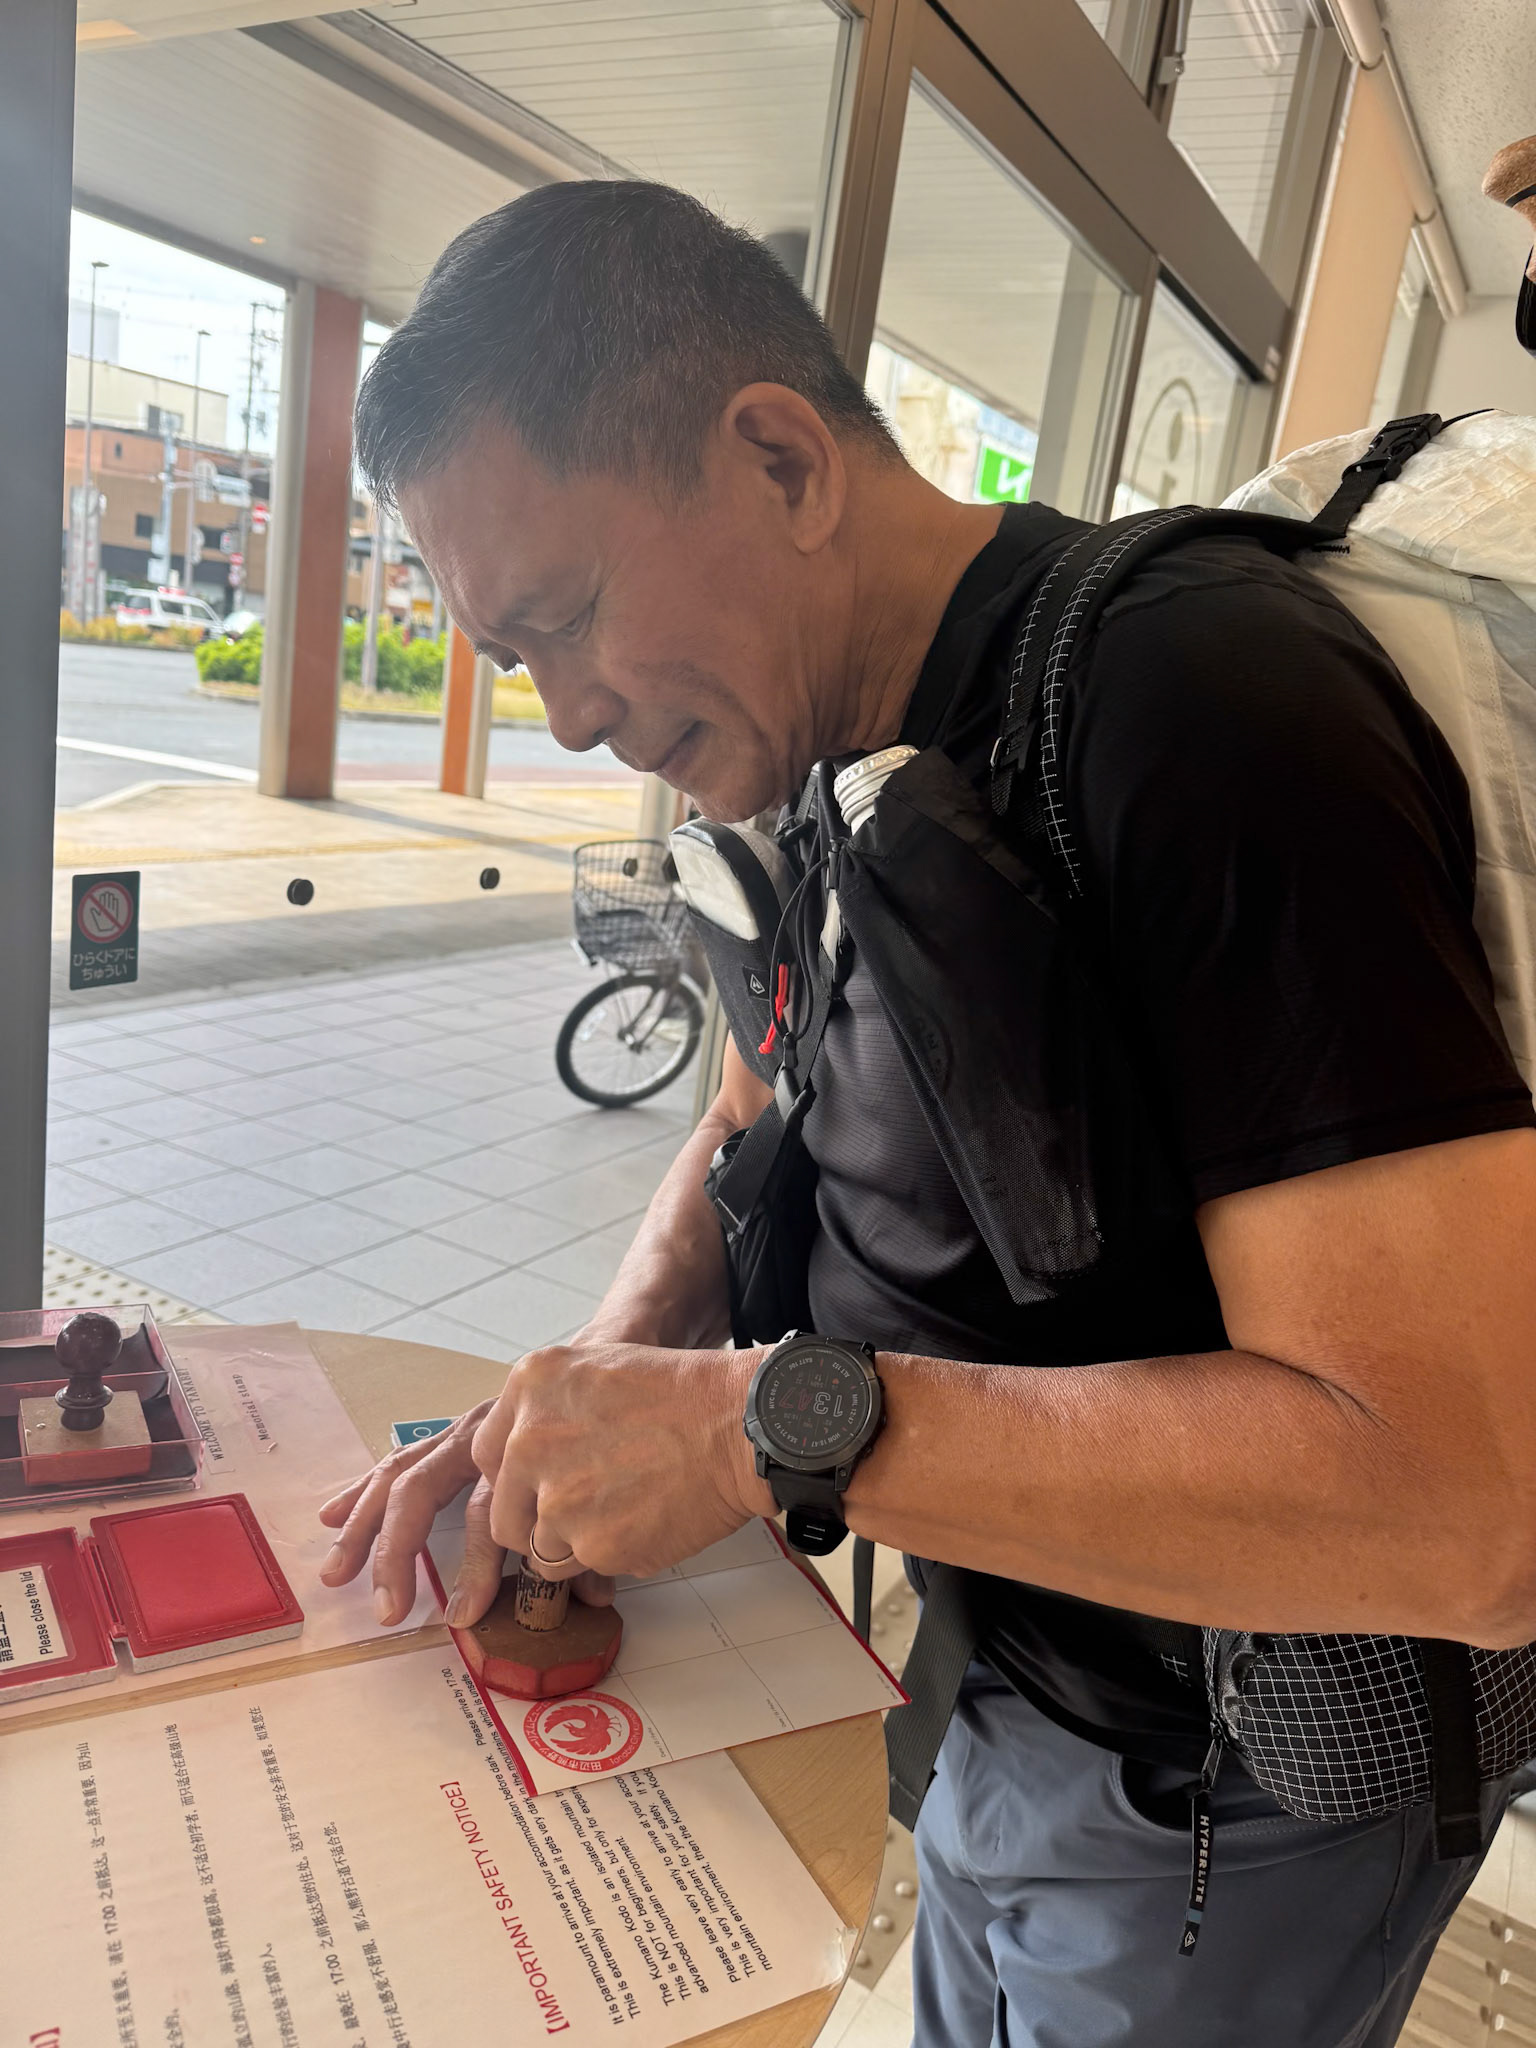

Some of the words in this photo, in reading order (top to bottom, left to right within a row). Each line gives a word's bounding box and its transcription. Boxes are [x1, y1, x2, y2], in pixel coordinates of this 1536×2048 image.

[73, 948, 135, 966] ひらくドアに
[82, 965, 127, 980] ちゅうい
[233, 1374, 250, 1397] stamp
[193, 1405, 206, 1416] TO
[242, 1400, 271, 1441] Memorial
[847, 1408, 857, 1424] 12:47
[199, 1420, 224, 1460] WELCOME
[19, 1571, 33, 1583] lid
[25, 1583, 37, 1599] the
[31, 1599, 45, 1621] close
[39, 1624, 53, 1655] Please
[442, 1666, 457, 1687] 17:00.
[461, 1672, 479, 1697] unsafe.
[453, 1689, 463, 1698] by
[474, 1698, 482, 1706] is
[458, 1698, 473, 1718] arrive
[480, 1706, 494, 1729] which
[469, 1720, 486, 1746] Please
[485, 1753, 500, 1773] dark.
[496, 1774, 513, 1800] before
[512, 1771, 521, 1788] the
[626, 1770, 645, 1787] you
[519, 1788, 527, 1796] in
[522, 1794, 538, 1814] dark
[628, 1801, 647, 1819] your
[657, 1790, 682, 1824] Kumano
[534, 1817, 548, 1835] very
[560, 1800, 586, 1838] mountain
[586, 1817, 598, 1828] for
[639, 1820, 651, 1828] at
[648, 1803, 668, 1829] safety.
[509, 1801, 548, 1868] accommodation
[594, 1831, 609, 1847] only
[648, 1830, 667, 1854] arrive
[665, 1833, 684, 1851] your
[679, 1825, 691, 1839] the
[545, 1836, 562, 1855] gets
[688, 1840, 705, 1861] then
[580, 1841, 606, 1875] isolated
[604, 1849, 619, 1864] but
[615, 1836, 652, 1893] environment.
[664, 1856, 673, 1866] to
[678, 1854, 691, 1867] for
[1195, 1814, 1210, 1903] HYPERLITE
[471, 1849, 513, 1910] SAFETY
[542, 1870, 562, 1890] your
[559, 1864, 570, 1875] as
[669, 1869, 687, 1891] early
[603, 1877, 615, 1890] an
[617, 1866, 647, 1917] beginners,
[686, 1869, 719, 1914] important
[701, 1862, 742, 1922] environment,
[552, 1891, 564, 1901] at
[565, 1877, 596, 1926] important,
[612, 1893, 621, 1902] is
[684, 1894, 701, 1914] very
[102, 1905, 118, 1935] 17:00
[560, 1902, 579, 1930] arrive
[618, 1905, 637, 1932] Kodo
[643, 1920, 656, 1933] for
[649, 1895, 679, 1940] mountain
[574, 1932, 585, 1943] to
[698, 1916, 719, 1944] leave
[716, 1918, 733, 1939] very
[590, 1928, 622, 1978] extremely
[650, 1937, 671, 1960] NOT
[731, 1941, 741, 1951] is
[739, 1924, 773, 1971] mountain
[634, 1935, 662, 1980] Kumano
[668, 1963, 678, 1973] is
[672, 1942, 709, 1993] advanced
[715, 1946, 741, 1983] Please
[739, 1954, 756, 1978] This
[325, 1954, 344, 1985] 17:00
[578, 1943, 616, 2002] paramount
[106, 1940, 138, 2048] 所至关重要，请在
[618, 1981, 629, 1992] is
[659, 1983, 675, 2007] The
[675, 1975, 692, 2000] This
[609, 2004, 620, 2015] is
[624, 1993, 641, 2019] This
[612, 2015, 624, 2025] It
